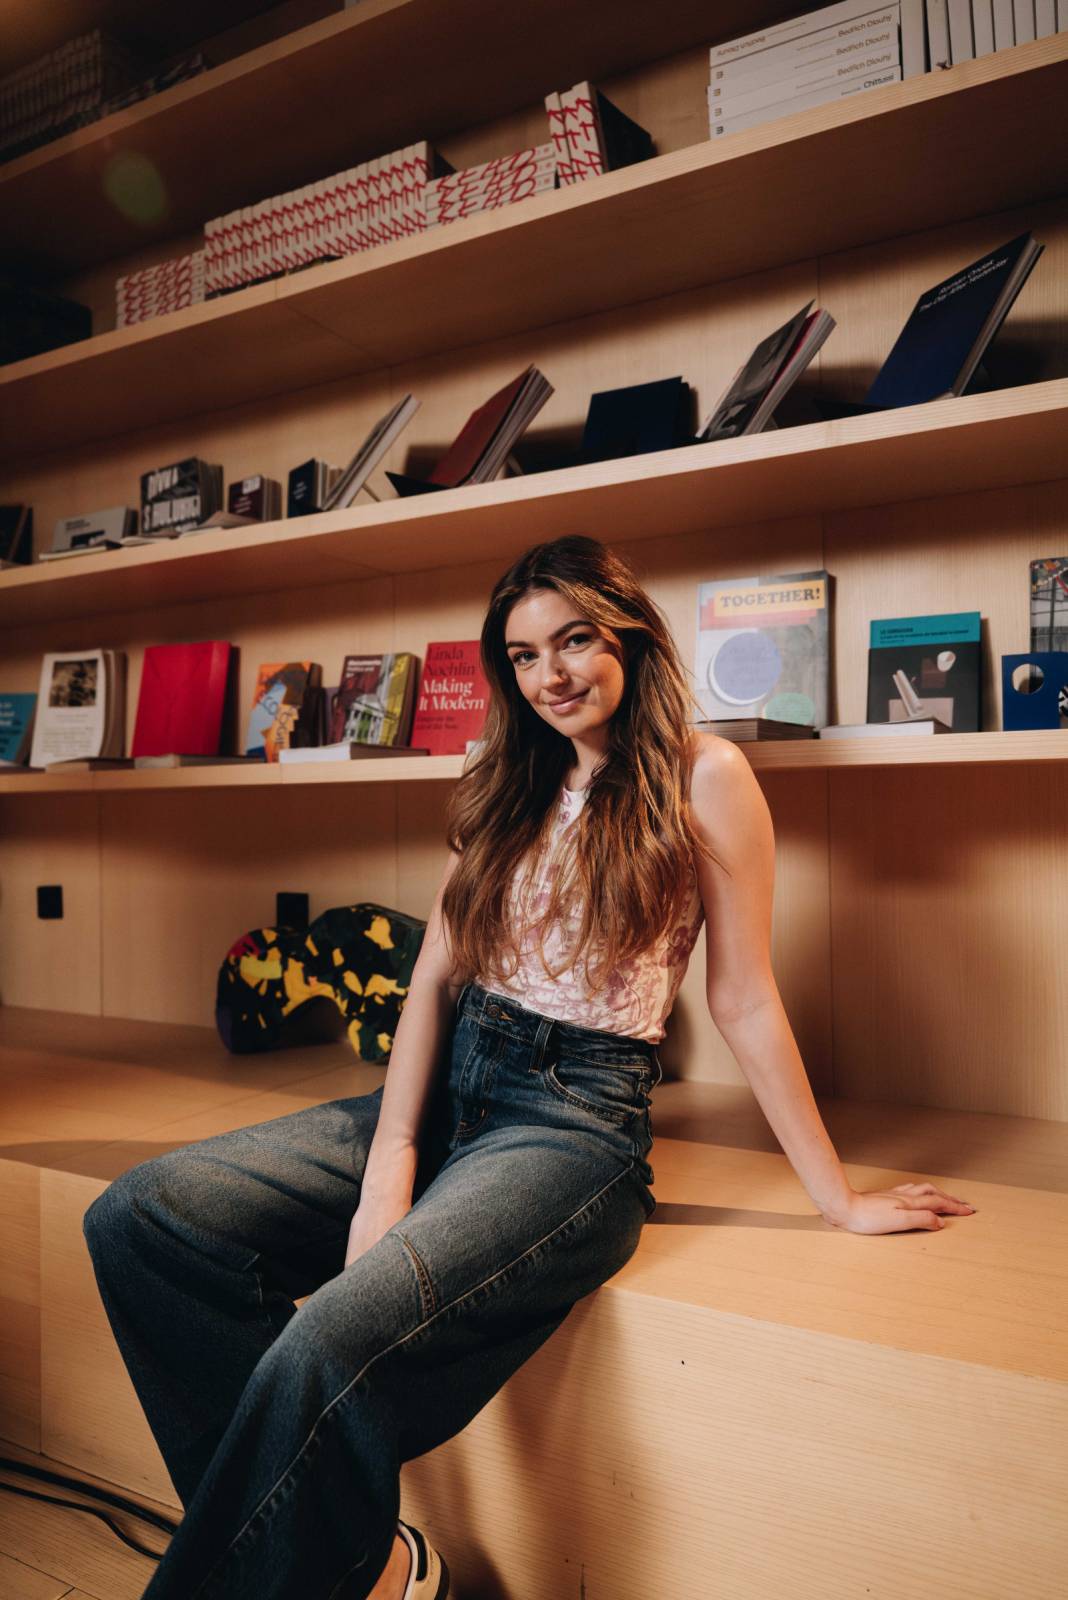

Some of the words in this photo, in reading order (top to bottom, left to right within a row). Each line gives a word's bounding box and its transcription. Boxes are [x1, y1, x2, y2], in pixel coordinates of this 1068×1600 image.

[720, 588, 820, 607] TOGETHER!
[424, 678, 473, 697] Making
[432, 696, 484, 710] Modern
